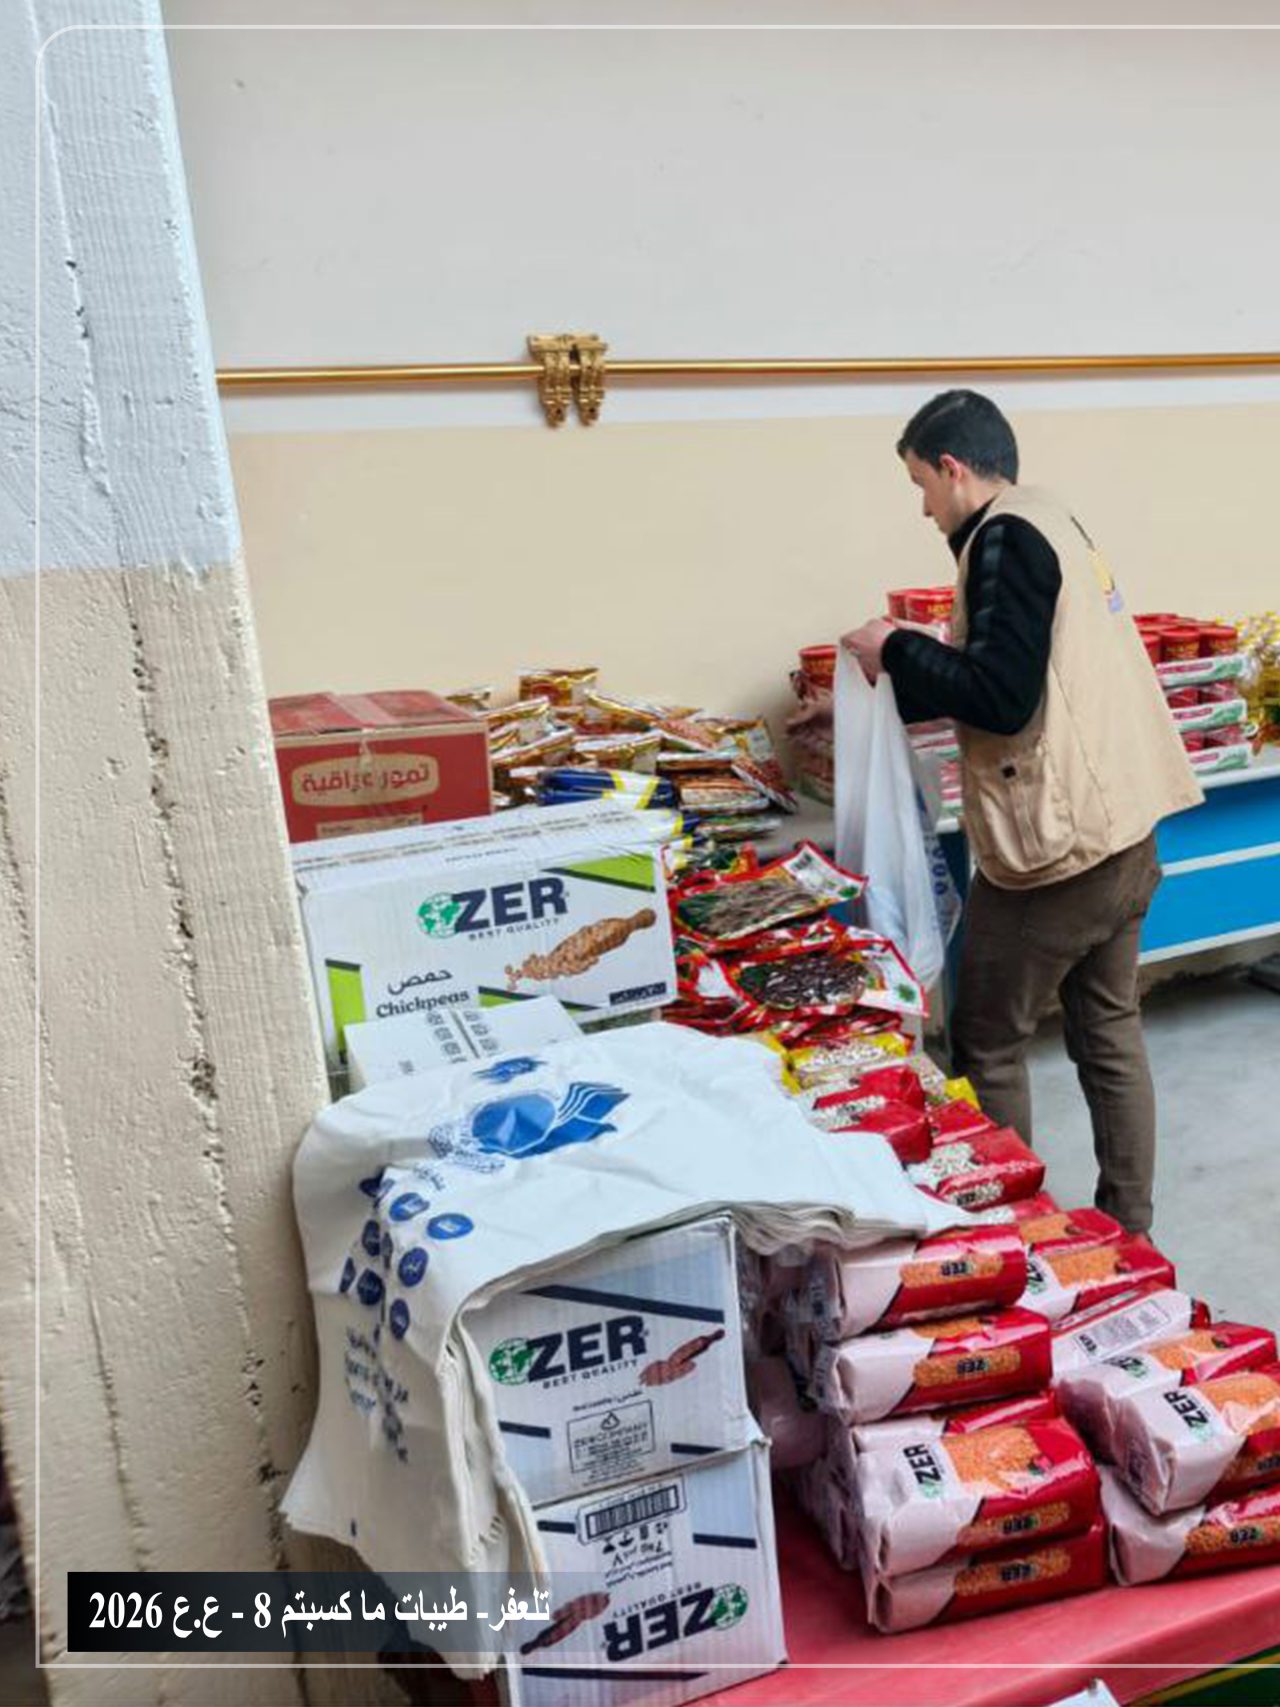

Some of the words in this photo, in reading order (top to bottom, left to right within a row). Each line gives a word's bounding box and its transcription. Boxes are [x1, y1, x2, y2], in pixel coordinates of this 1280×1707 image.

[302, 769, 374, 796] عراقية
[381, 762, 430, 789] تمور
[452, 877, 568, 933] ZER
[469, 929, 501, 942] BEST
[506, 917, 559, 935] QUALITY
[387, 969, 453, 996] حمص
[376, 990, 470, 1018] Chickpeas
[940, 1260, 969, 1276] ZER
[527, 1314, 647, 1383] ZER
[542, 1373, 577, 1390] BEST
[581, 1358, 639, 1380] QUALITY
[956, 1360, 984, 1376] ZER
[1164, 1390, 1209, 1428] ZER
[903, 1443, 942, 1485] ZER
[612, 1593, 666, 1619] QUALITY
[603, 1587, 715, 1662] ZER
